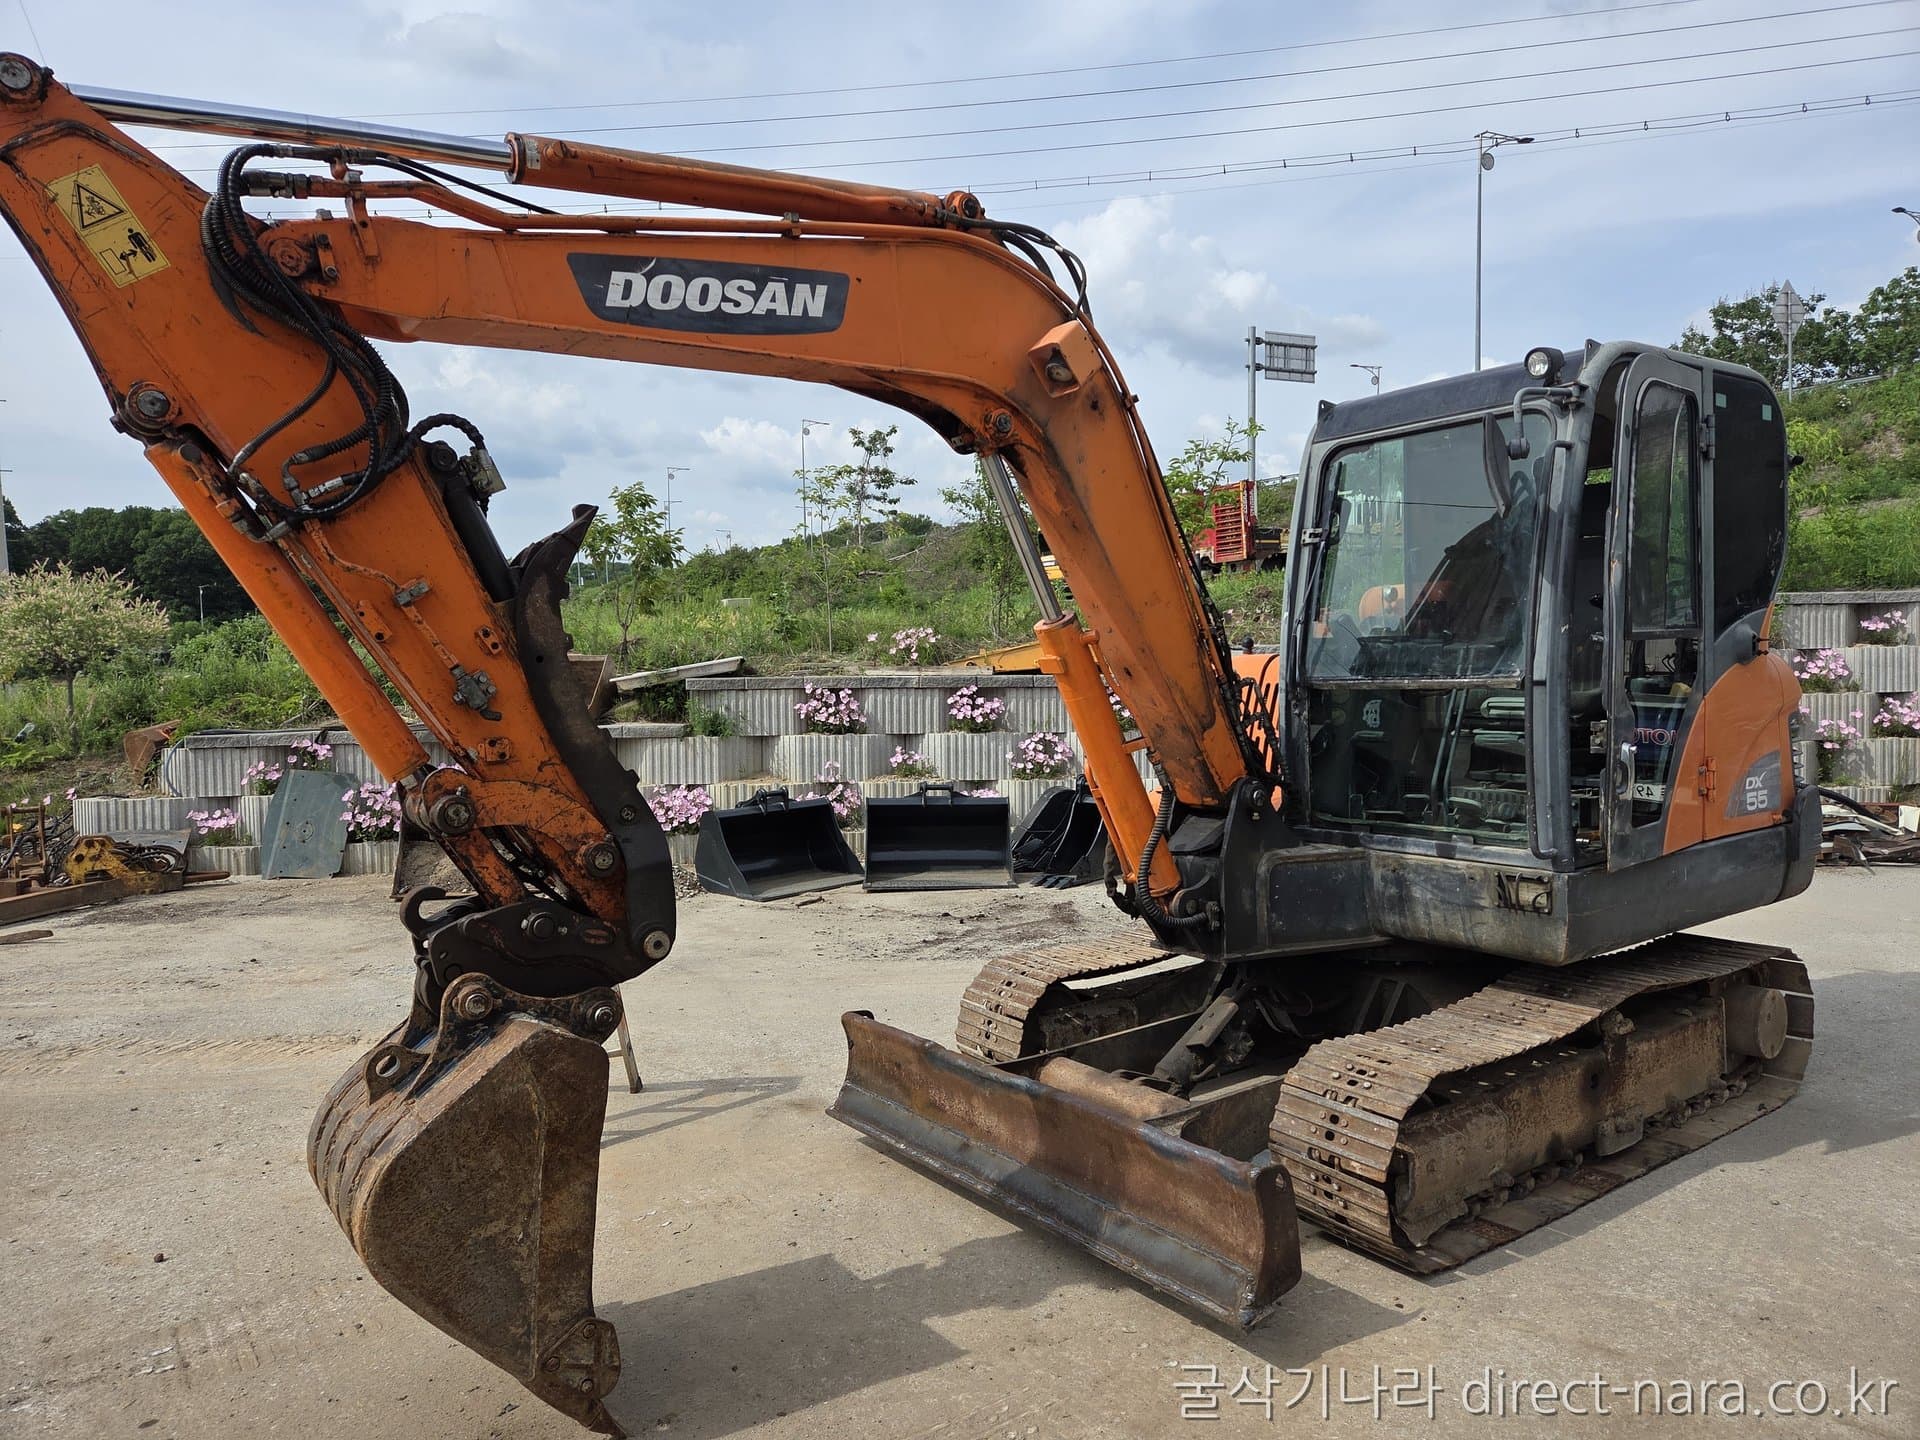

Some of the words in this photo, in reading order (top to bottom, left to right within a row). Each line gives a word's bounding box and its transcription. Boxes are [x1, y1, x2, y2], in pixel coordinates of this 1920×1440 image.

[605, 259, 828, 318] DOOSAN
[1745, 771, 1768, 790] DX
[1746, 789, 1769, 811] 55
